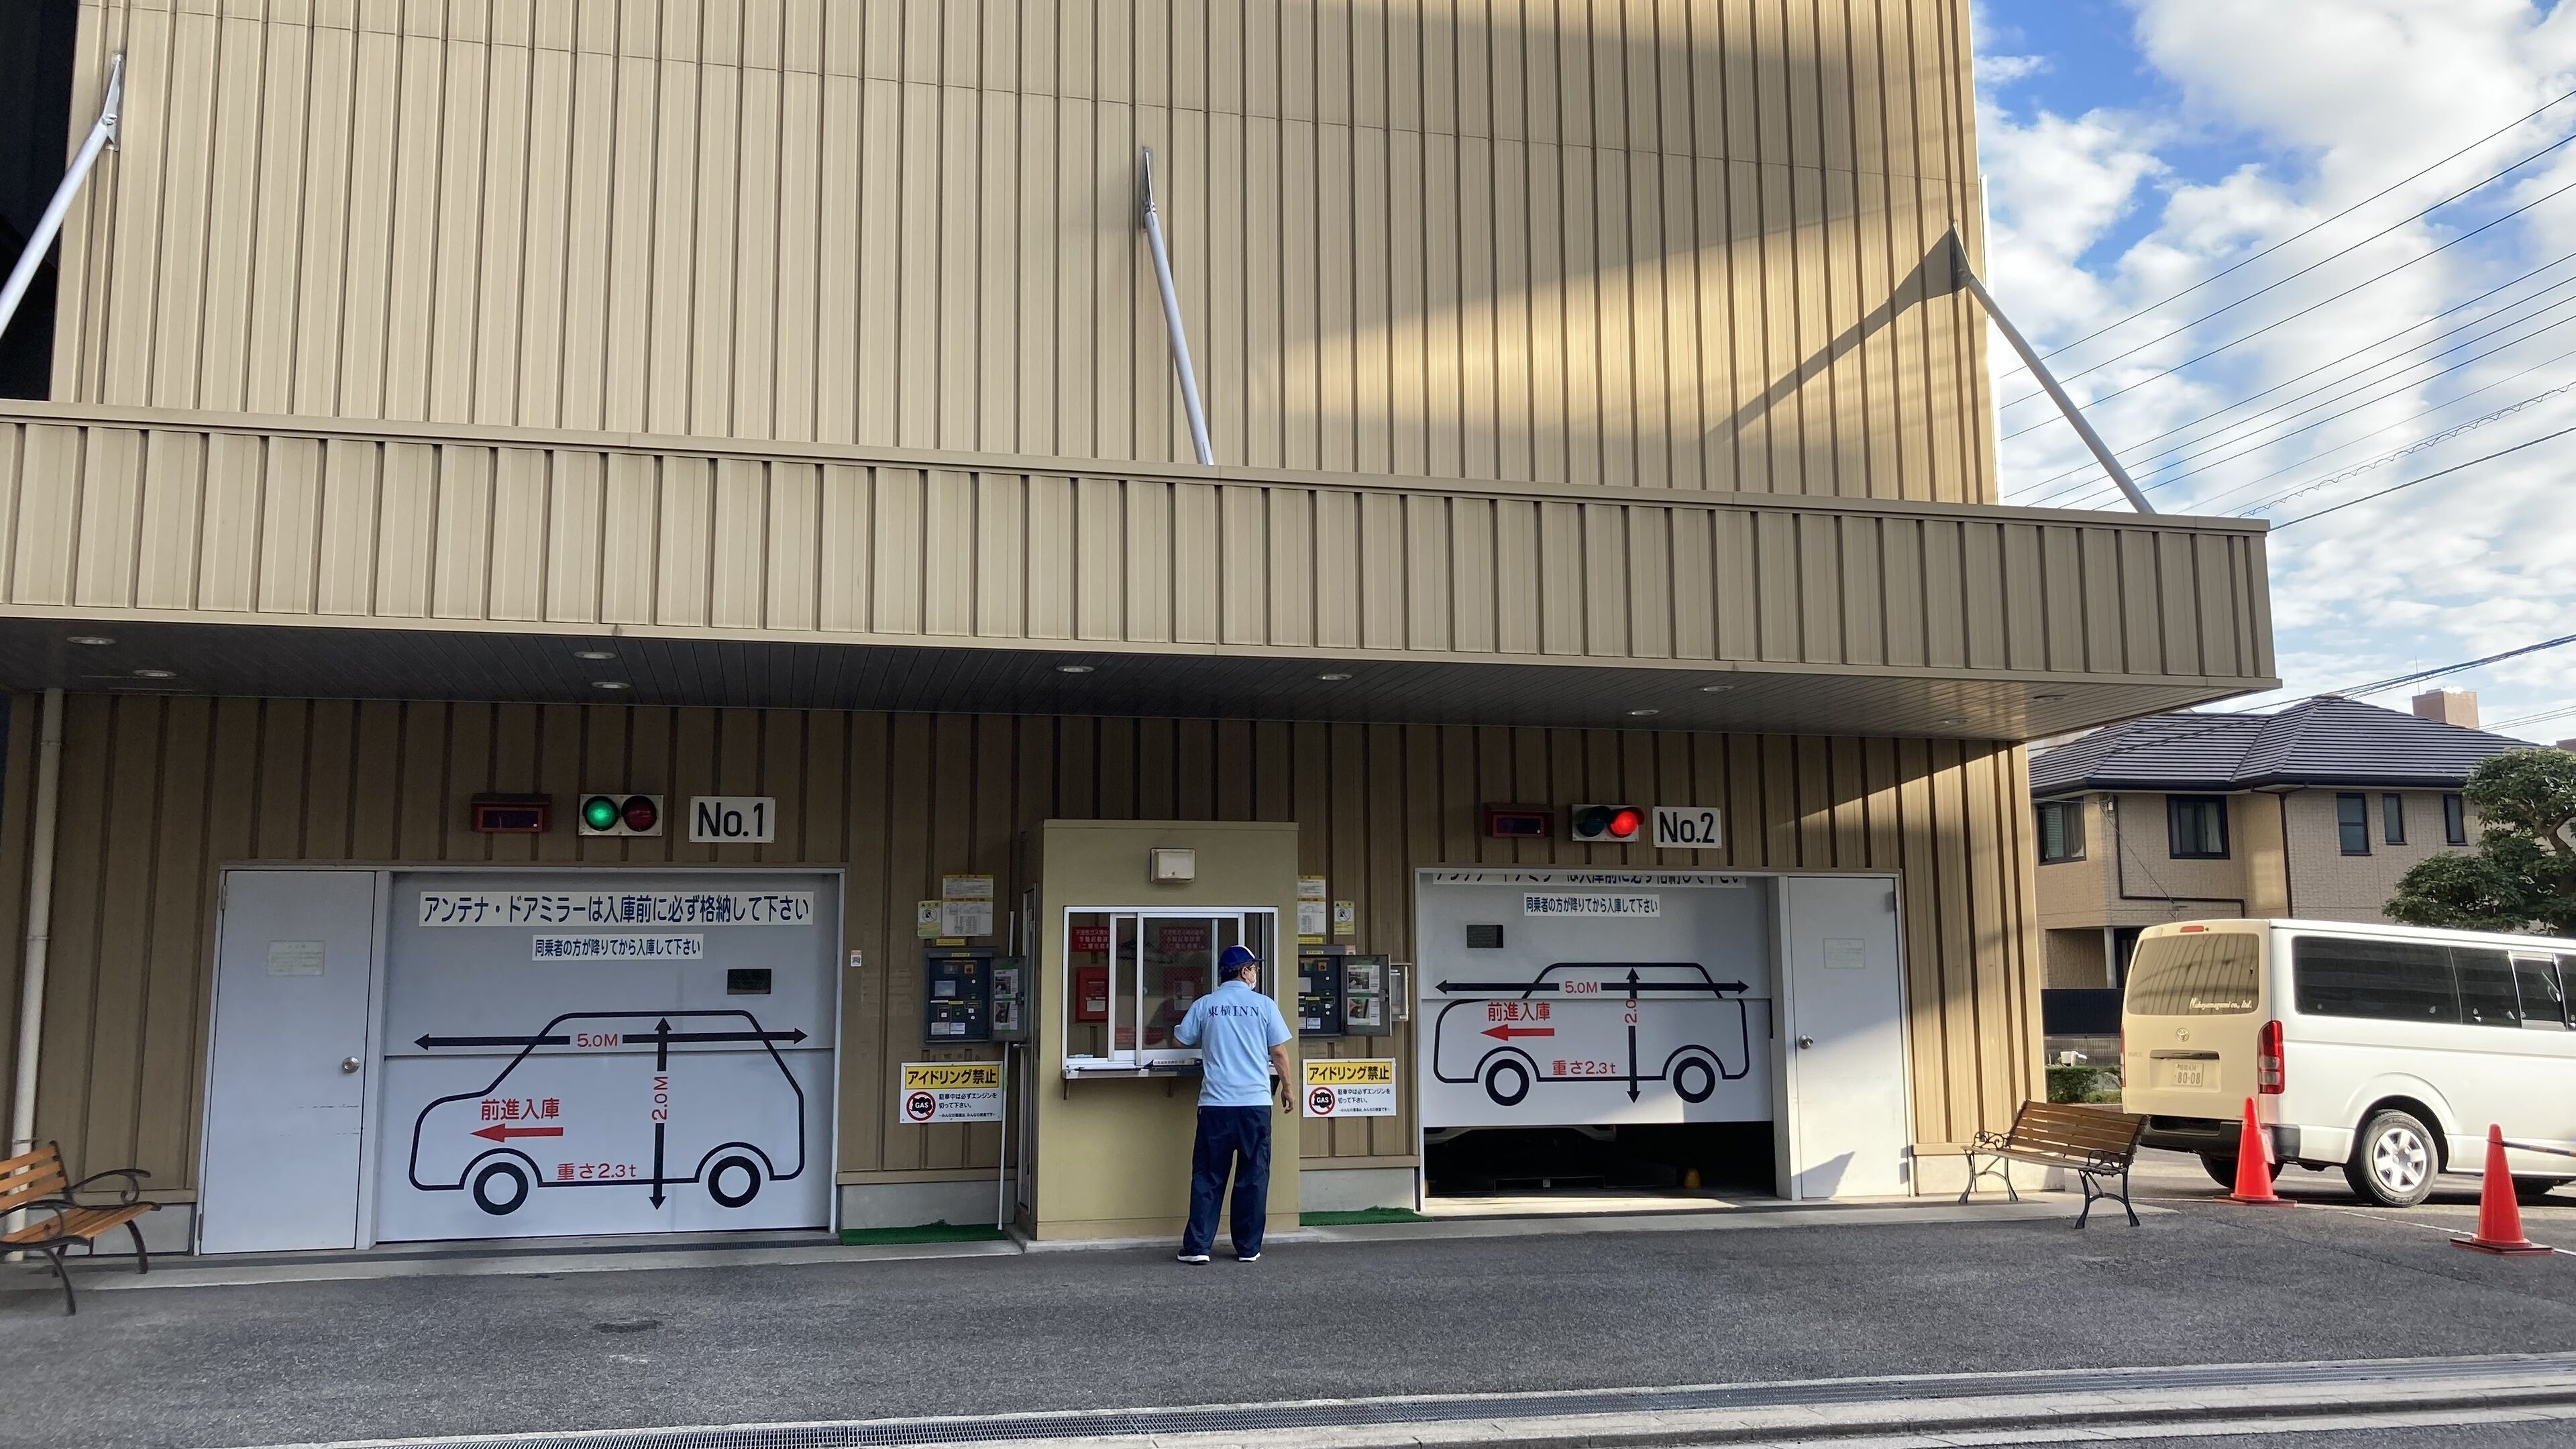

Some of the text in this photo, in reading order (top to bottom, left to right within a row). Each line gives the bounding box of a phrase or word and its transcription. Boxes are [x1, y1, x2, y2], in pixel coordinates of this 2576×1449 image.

[697, 802, 765, 838] No.1
[1659, 811, 1715, 844] No.2
[423, 894, 809, 924] アンテナ・ドアミラーは入庫前に必ず格納して下さい
[1525, 896, 1658, 914] 同乗者の方が降りてから入庫して下さい
[535, 938, 701, 957] 同乗者の方が降りてから入庫して下さい
[1564, 980, 1598, 994] 5.0M
[1487, 1002, 1551, 1022] 前進入庫
[576, 1032, 619, 1048] 5.0M
[908, 1068, 997, 1085] アイドリング禁止
[1309, 1065, 1390, 1081] アイドリング禁止
[651, 1075, 668, 1121] 2.0M
[481, 1098, 560, 1121] 前進入庫
